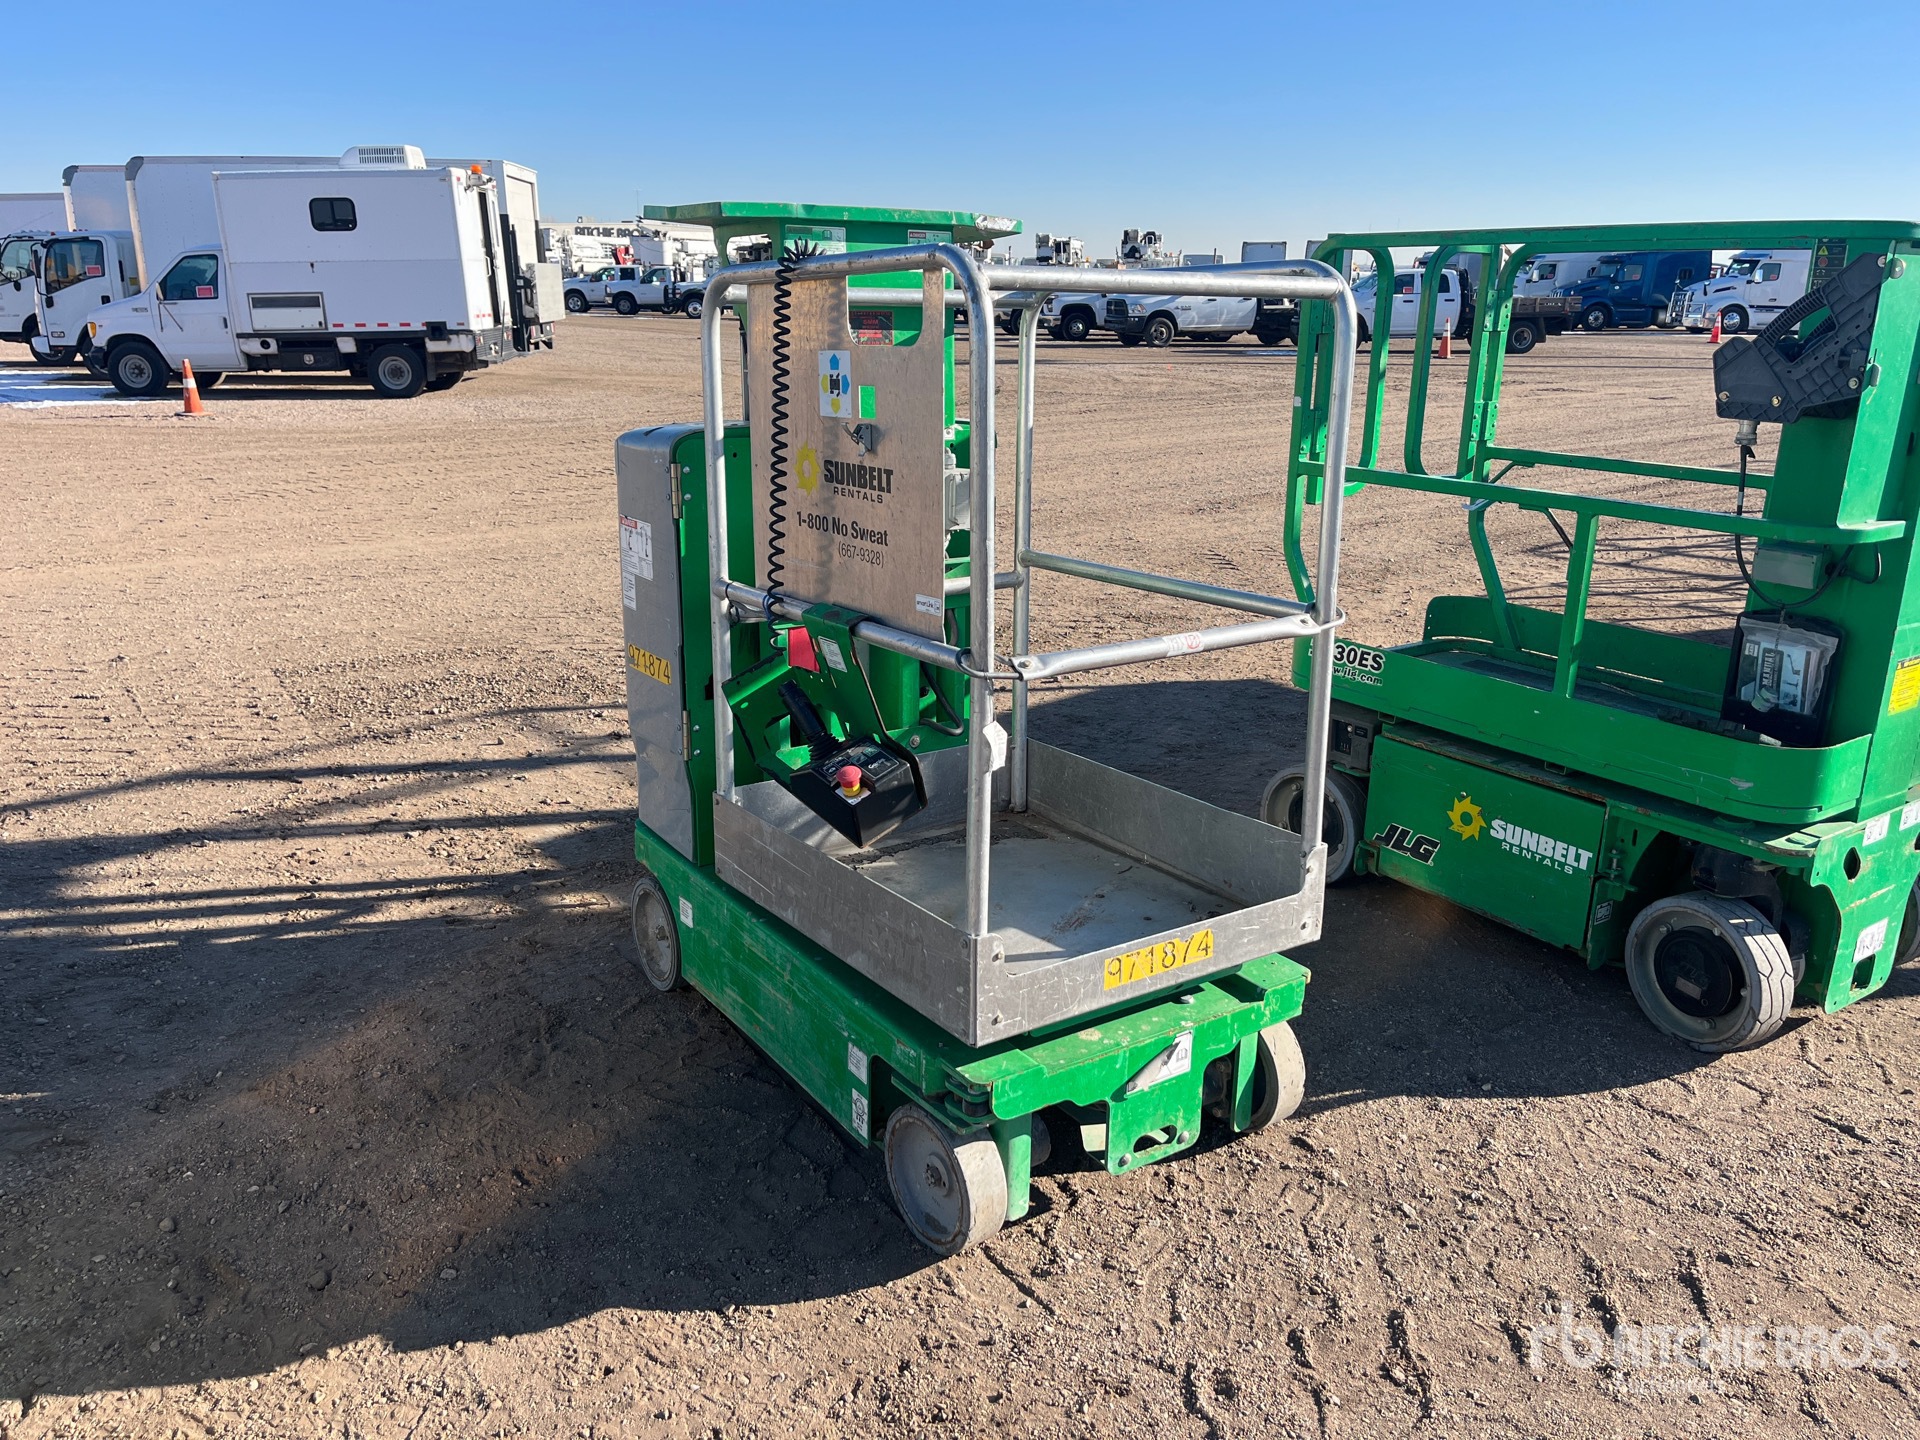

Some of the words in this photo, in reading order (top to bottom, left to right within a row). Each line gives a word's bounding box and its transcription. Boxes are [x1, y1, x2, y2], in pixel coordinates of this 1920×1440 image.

[823, 459, 894, 494] SUNBELT
[833, 486, 884, 504] RENTALS
[796, 510, 829, 532] 1-800
[832, 516, 848, 537] No
[851, 520, 889, 547] Sweat
[838, 540, 884, 569] (667-9328)
[628, 643, 671, 684] 971874
[1333, 643, 1385, 673] 30ES
[1333, 666, 1383, 686] w.jlg.com
[1373, 823, 1441, 864] JLG
[1489, 818, 1594, 871] SUNBELT
[1501, 841, 1575, 875] RENTALS
[1107, 930, 1211, 984] 971874
